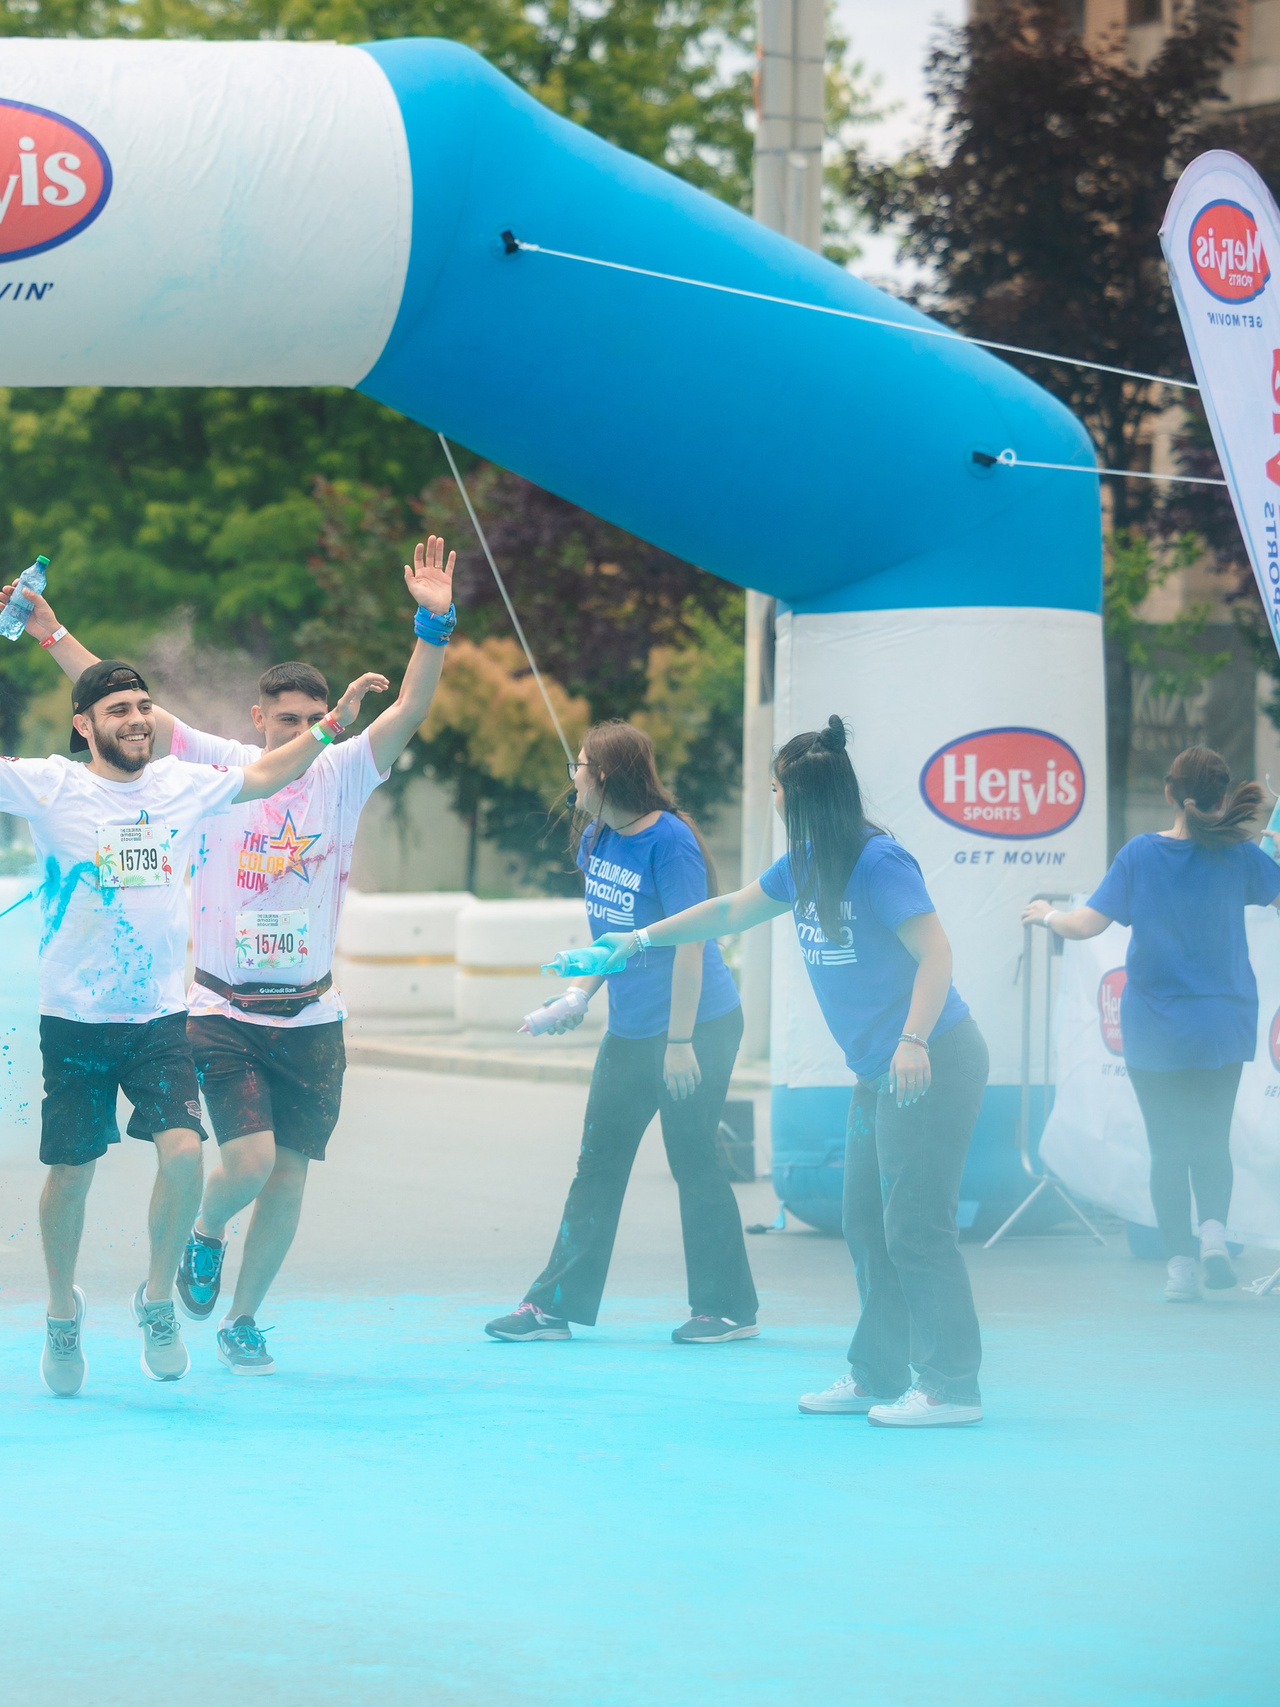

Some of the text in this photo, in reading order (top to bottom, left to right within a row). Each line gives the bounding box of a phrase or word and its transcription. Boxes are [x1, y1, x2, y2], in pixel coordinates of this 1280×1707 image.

[942, 754, 1077, 816] Hervis
[963, 806, 1023, 821] SPORTS
[243, 830, 269, 854] THE
[119, 848, 158, 871] 15739
[239, 849, 285, 877] COLOR
[954, 851, 1066, 866] GET MOVIN'
[585, 876, 635, 913] mazing
[255, 933, 294, 954] 15740
